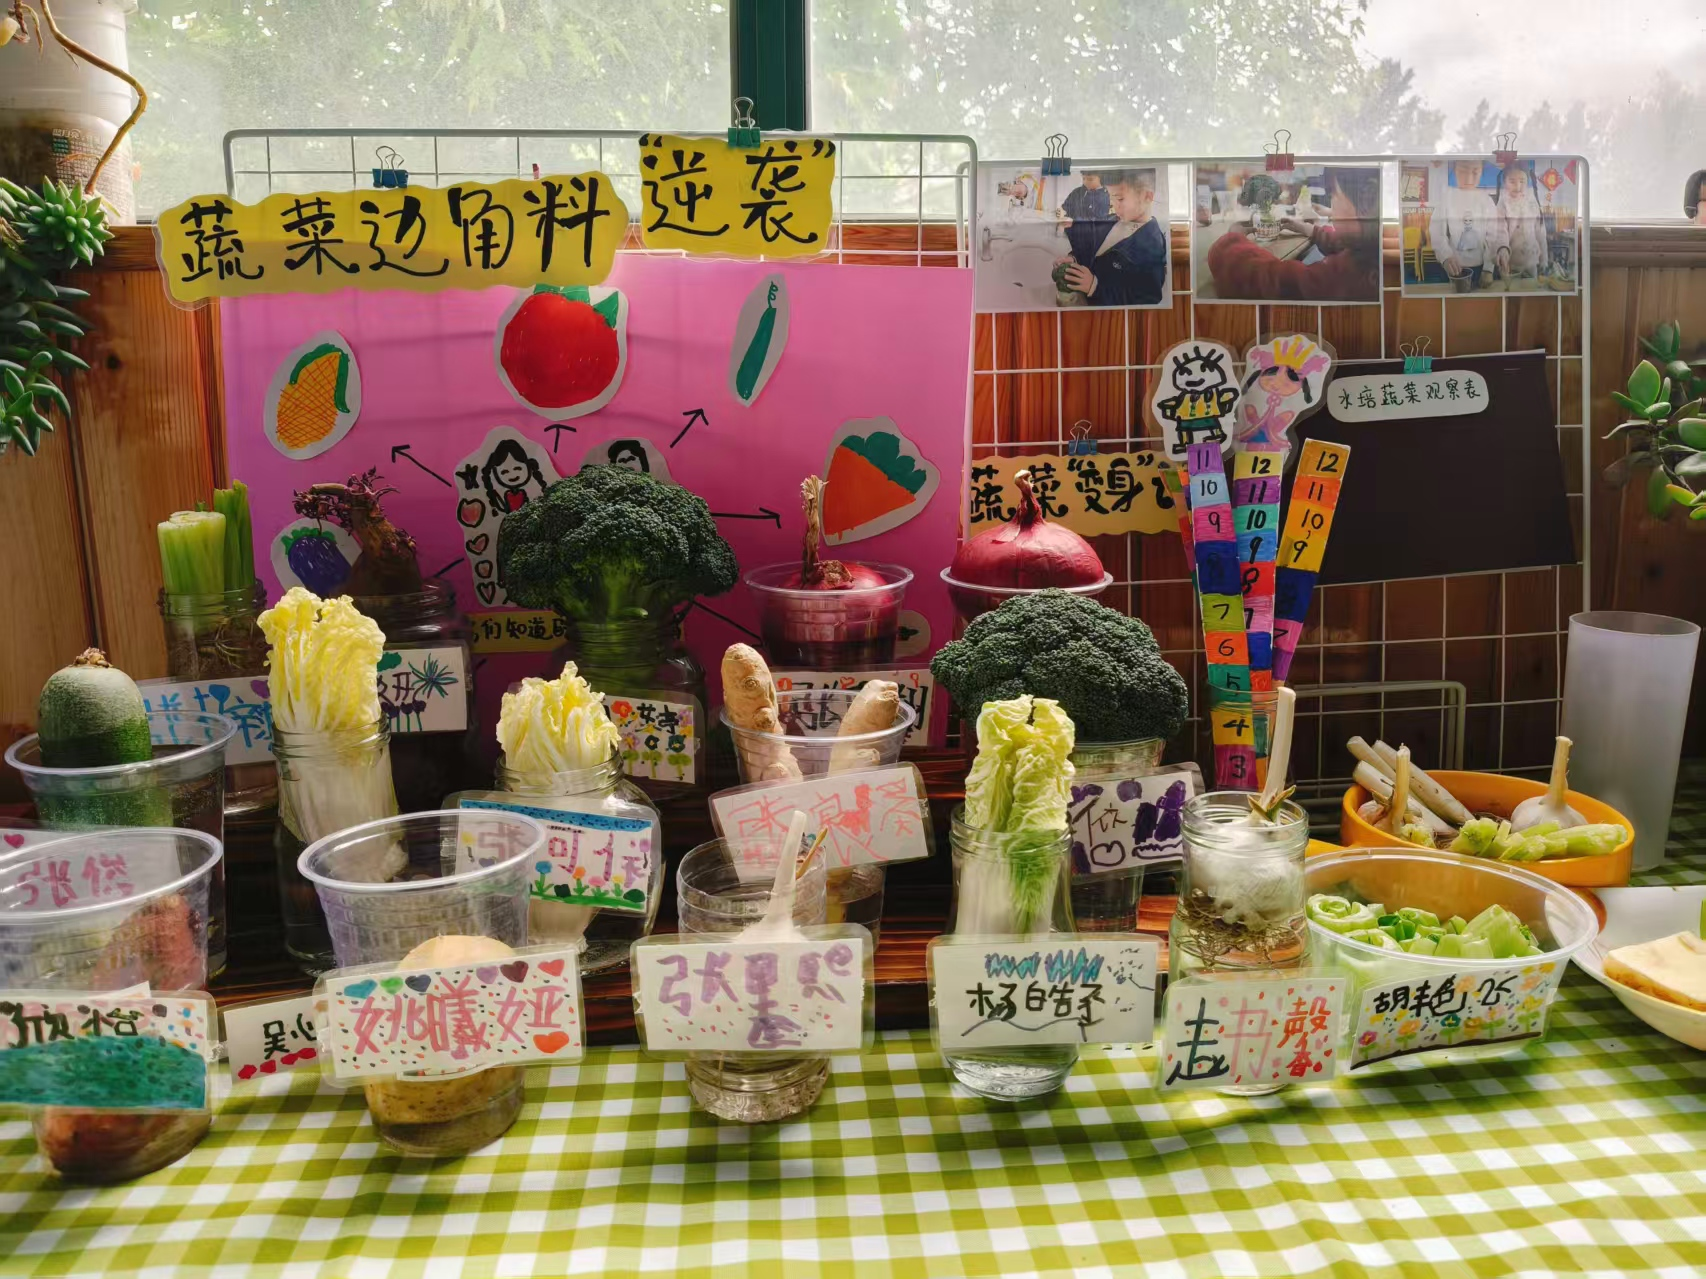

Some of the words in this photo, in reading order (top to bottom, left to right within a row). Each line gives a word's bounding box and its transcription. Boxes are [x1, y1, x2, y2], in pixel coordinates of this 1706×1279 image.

[181, 177, 610, 282] 蔬菜边角料
[1338, 378, 1481, 410] 水培蔬菜观察表
[1197, 450, 1210, 470] 11
[1251, 455, 1271, 475] 12
[1316, 450, 1339, 473] 12
[1201, 479, 1218, 497] 10
[1248, 479, 1269, 499] 11
[1308, 482, 1324, 501] 11
[1208, 511, 1221, 534] 9
[1246, 509, 1266, 530] 10
[1301, 510, 1324, 530] 10
[1249, 536, 1263, 564] 9
[1293, 540, 1308, 563] 9
[1241, 567, 1260, 594] 8
[1213, 603, 1229, 620] 7
[1218, 638, 1235, 656] 6
[1226, 672, 1242, 694] 5
[1223, 714, 1250, 737] 4
[1228, 755, 1247, 779] 3
